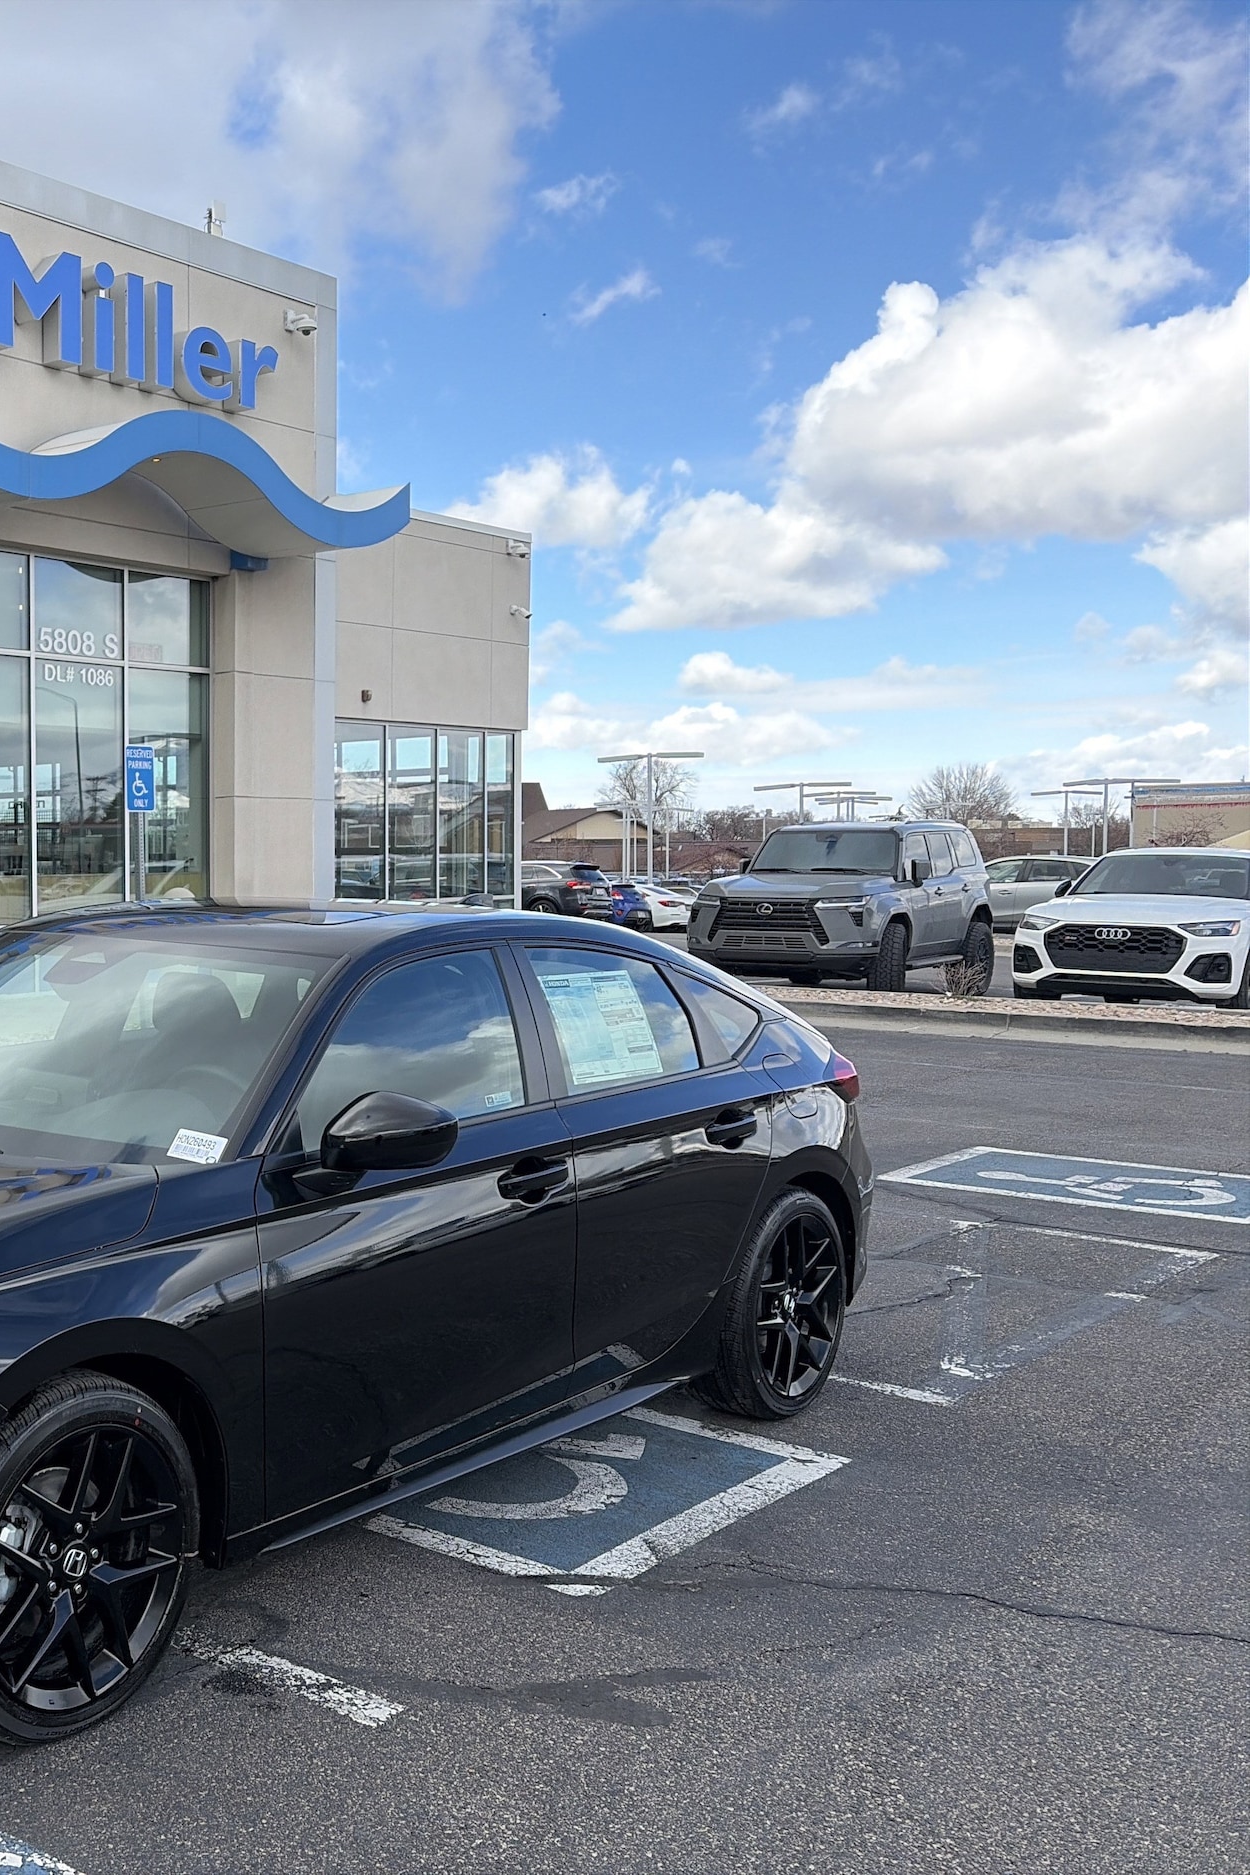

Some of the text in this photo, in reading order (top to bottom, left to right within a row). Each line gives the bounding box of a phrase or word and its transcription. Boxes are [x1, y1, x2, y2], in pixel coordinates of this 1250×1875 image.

[39, 627, 119, 658] 5808 S
[44, 663, 114, 687] DL# 1086
[126, 748, 152, 759] RESERVED
[128, 760, 152, 770] PARKING
[134, 798, 149, 808] ONLY
